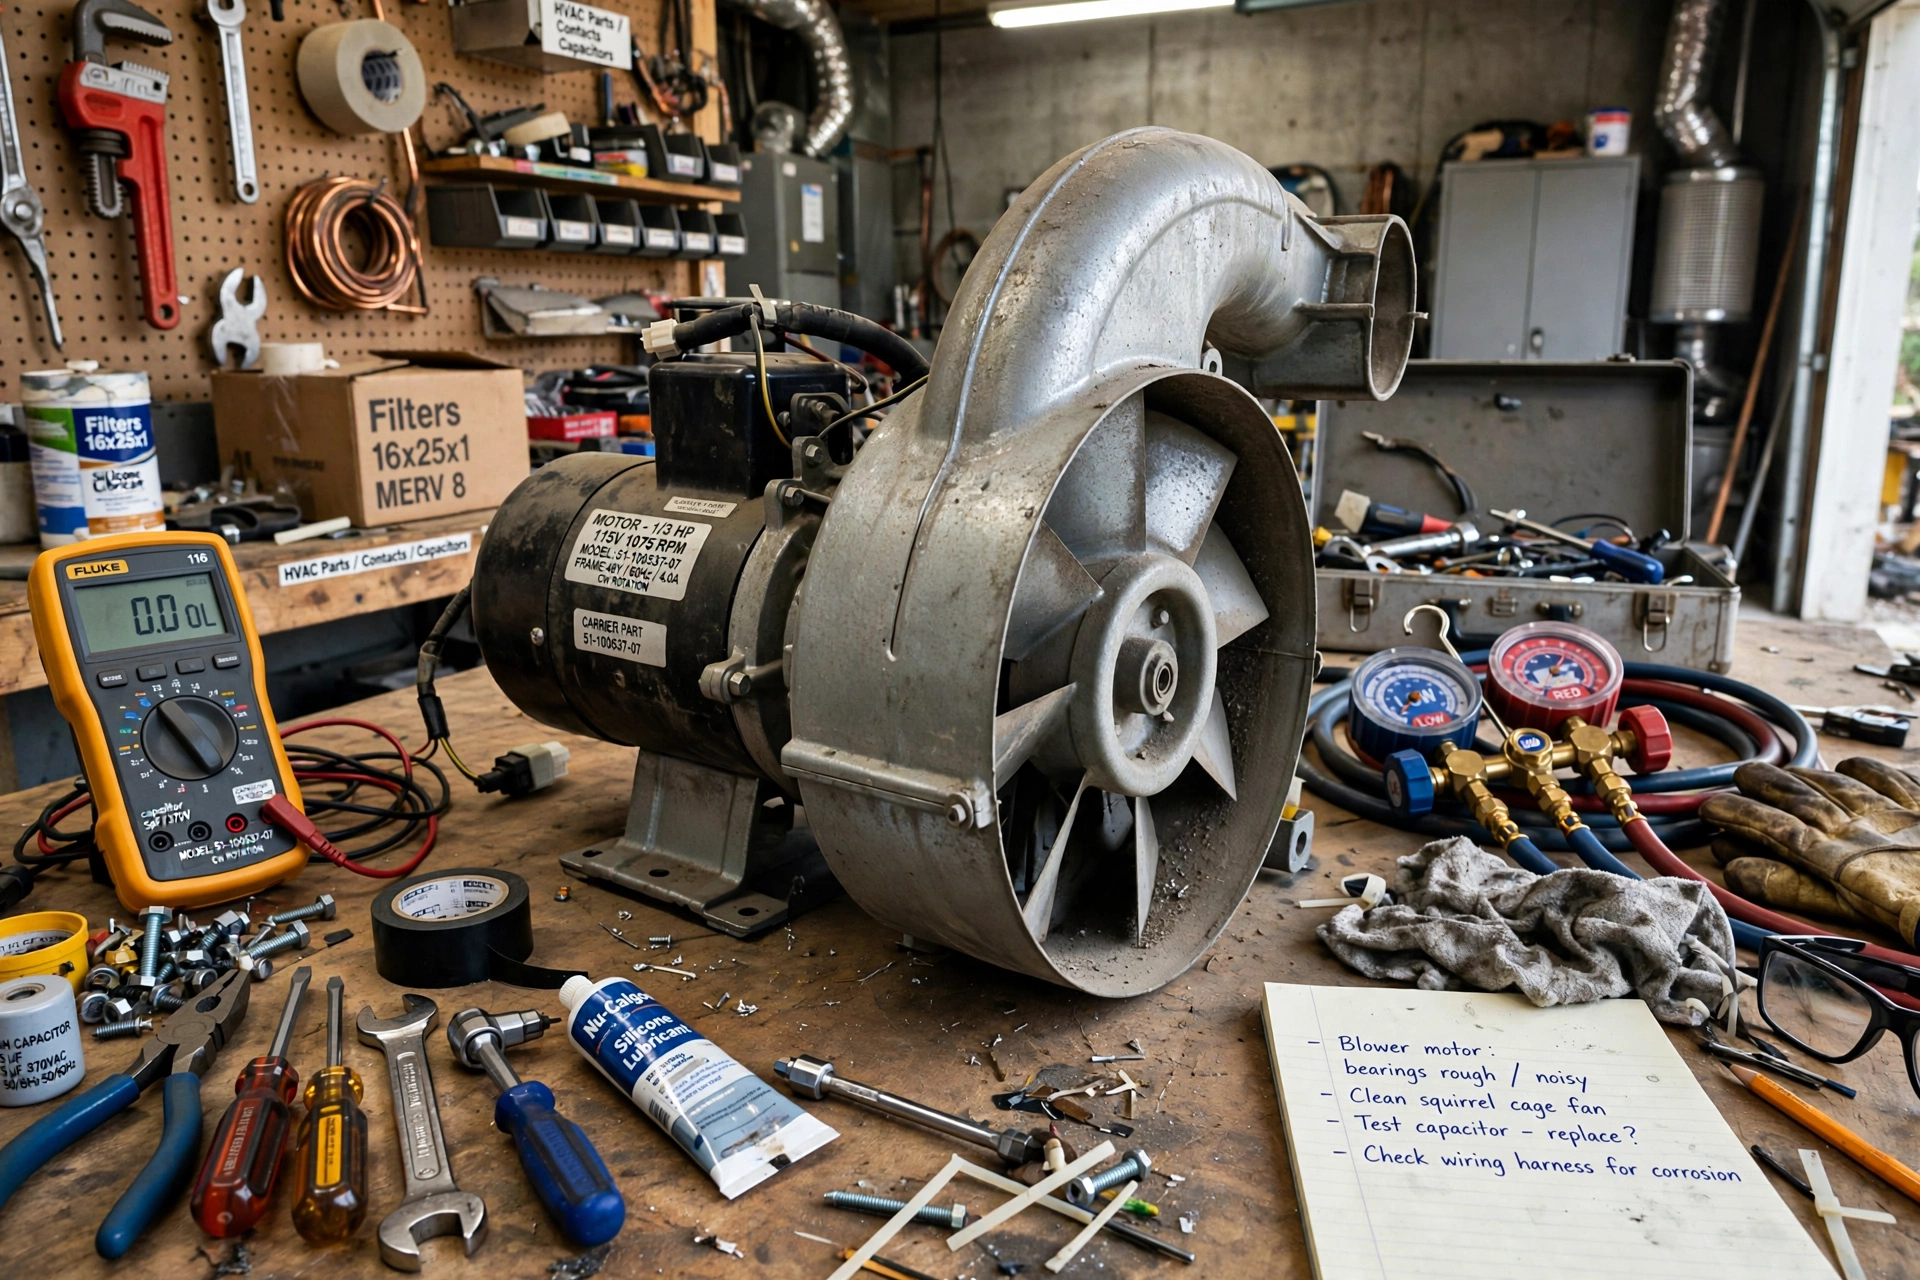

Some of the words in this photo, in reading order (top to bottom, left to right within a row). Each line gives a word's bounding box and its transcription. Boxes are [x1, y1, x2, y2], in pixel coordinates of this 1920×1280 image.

[554, 2, 585, 21] HVAC
[588, 10, 614, 29] Parts
[84, 415, 143, 434] Filters
[368, 397, 461, 433] Filters
[84, 430, 149, 451] 16x25x1
[372, 434, 471, 471] 16x25x1
[375, 473, 444, 510] MERV
[452, 471, 466, 499] 8
[593, 513, 642, 531] MOTOR
[651, 521, 672, 536] 1/3
[674, 525, 696, 539] HP
[593, 529, 624, 545] 115V
[626, 534, 657, 551] 1075
[655, 539, 688, 555] RPM
[74, 562, 120, 577] FLUKE
[187, 553, 208, 565] 116
[284, 562, 318, 581] HVAC
[321, 559, 350, 574] Parts
[353, 555, 359, 569] /
[361, 549, 407, 567] Contacts
[417, 538, 468, 558] Capacitors
[611, 576, 650, 592] ROTATION
[130, 594, 180, 636] 0.0
[582, 616, 619, 634] CARRIER
[621, 623, 643, 638] PART
[1553, 686, 1582, 701] RED
[1415, 712, 1444, 727] LOW
[14, 1020, 71, 1050] CAPACITOR
[614, 1014, 674, 1054] Silicone
[622, 1023, 693, 1071] Lubricant
[1338, 1035, 1410, 1053] Blower
[27, 1050, 67, 1073] 370VAC
[1344, 1058, 1427, 1085] bearings
[1440, 1065, 1496, 1087] rough
[1511, 1062, 1520, 1087] /
[1536, 1070, 1587, 1093] noisy
[1350, 1087, 1407, 1105] Clean
[1420, 1092, 1496, 1114] squirrel
[1510, 1100, 1557, 1120] cage
[1567, 1096, 1607, 1116] fan
[1354, 1114, 1402, 1132] Test
[1416, 1120, 1509, 1140] capacitor
[1547, 1124, 1638, 1148] replace?
[1364, 1145, 1429, 1165] Check
[1441, 1151, 1505, 1177] wiring
[1514, 1151, 1594, 1174] harness
[1606, 1156, 1638, 1176] for
[1652, 1165, 1742, 1182] corrosion
